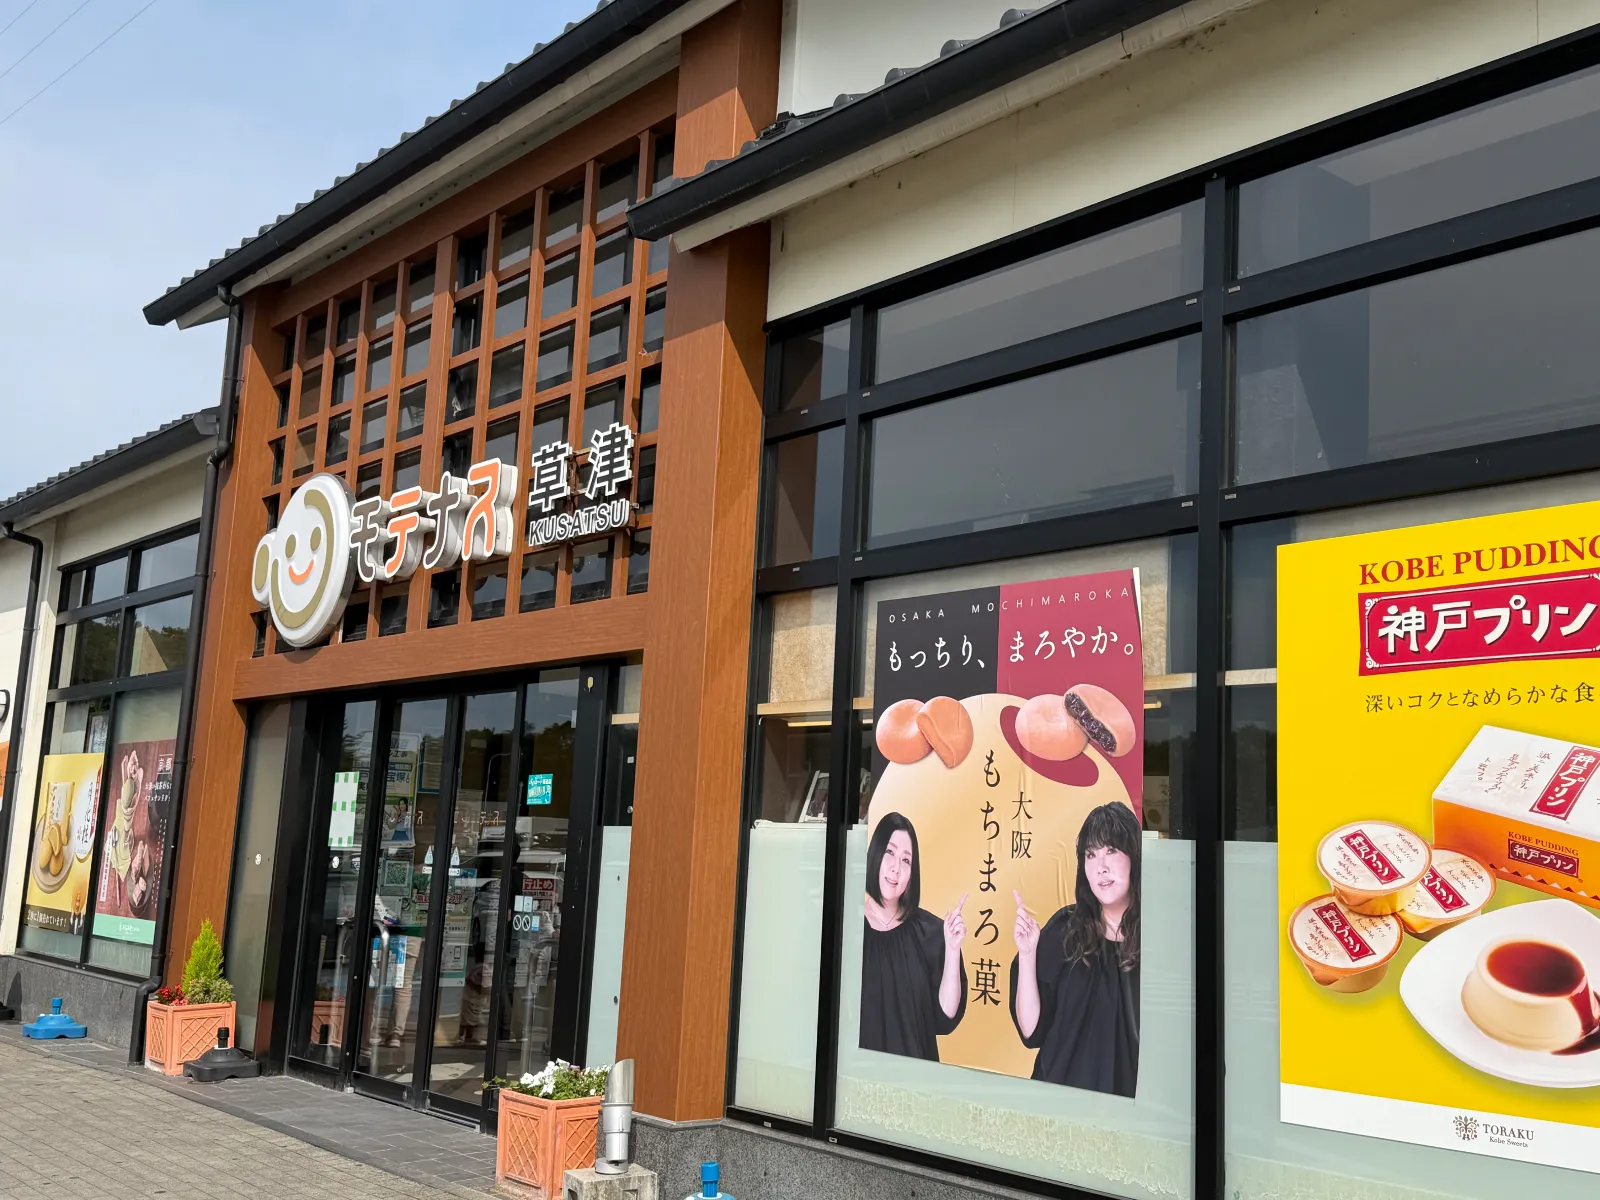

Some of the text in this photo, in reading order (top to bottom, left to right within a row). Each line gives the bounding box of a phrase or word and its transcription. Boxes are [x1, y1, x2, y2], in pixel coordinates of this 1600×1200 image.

[528, 422, 633, 512] 草津
[349, 457, 504, 583] モテナス
[528, 498, 630, 547] KUSATSU
[1359, 555, 1445, 585] KOBE
[888, 587, 1129, 623] OSAKA MOCHIMAROKA
[1377, 594, 1597, 653] 神戸プリン
[889, 625, 1134, 672] もっちり、 まろやか。
[1365, 682, 1600, 713] 深いコクとなめらかな食
[1546, 752, 1597, 807] 神戸プリン
[1011, 791, 1033, 859] 大阪
[1508, 831, 1579, 856] KOBE PUDDING
[970, 749, 1001, 1006] もちまろ菓
[1349, 835, 1390, 877] 神戸プリン
[1513, 844, 1574, 870] 神戸プリン
[1321, 909, 1361, 953] 神戸プリン
[1483, 1124, 1534, 1140] TORAKU
[1489, 1136, 1529, 1148] Kobe Sweets
